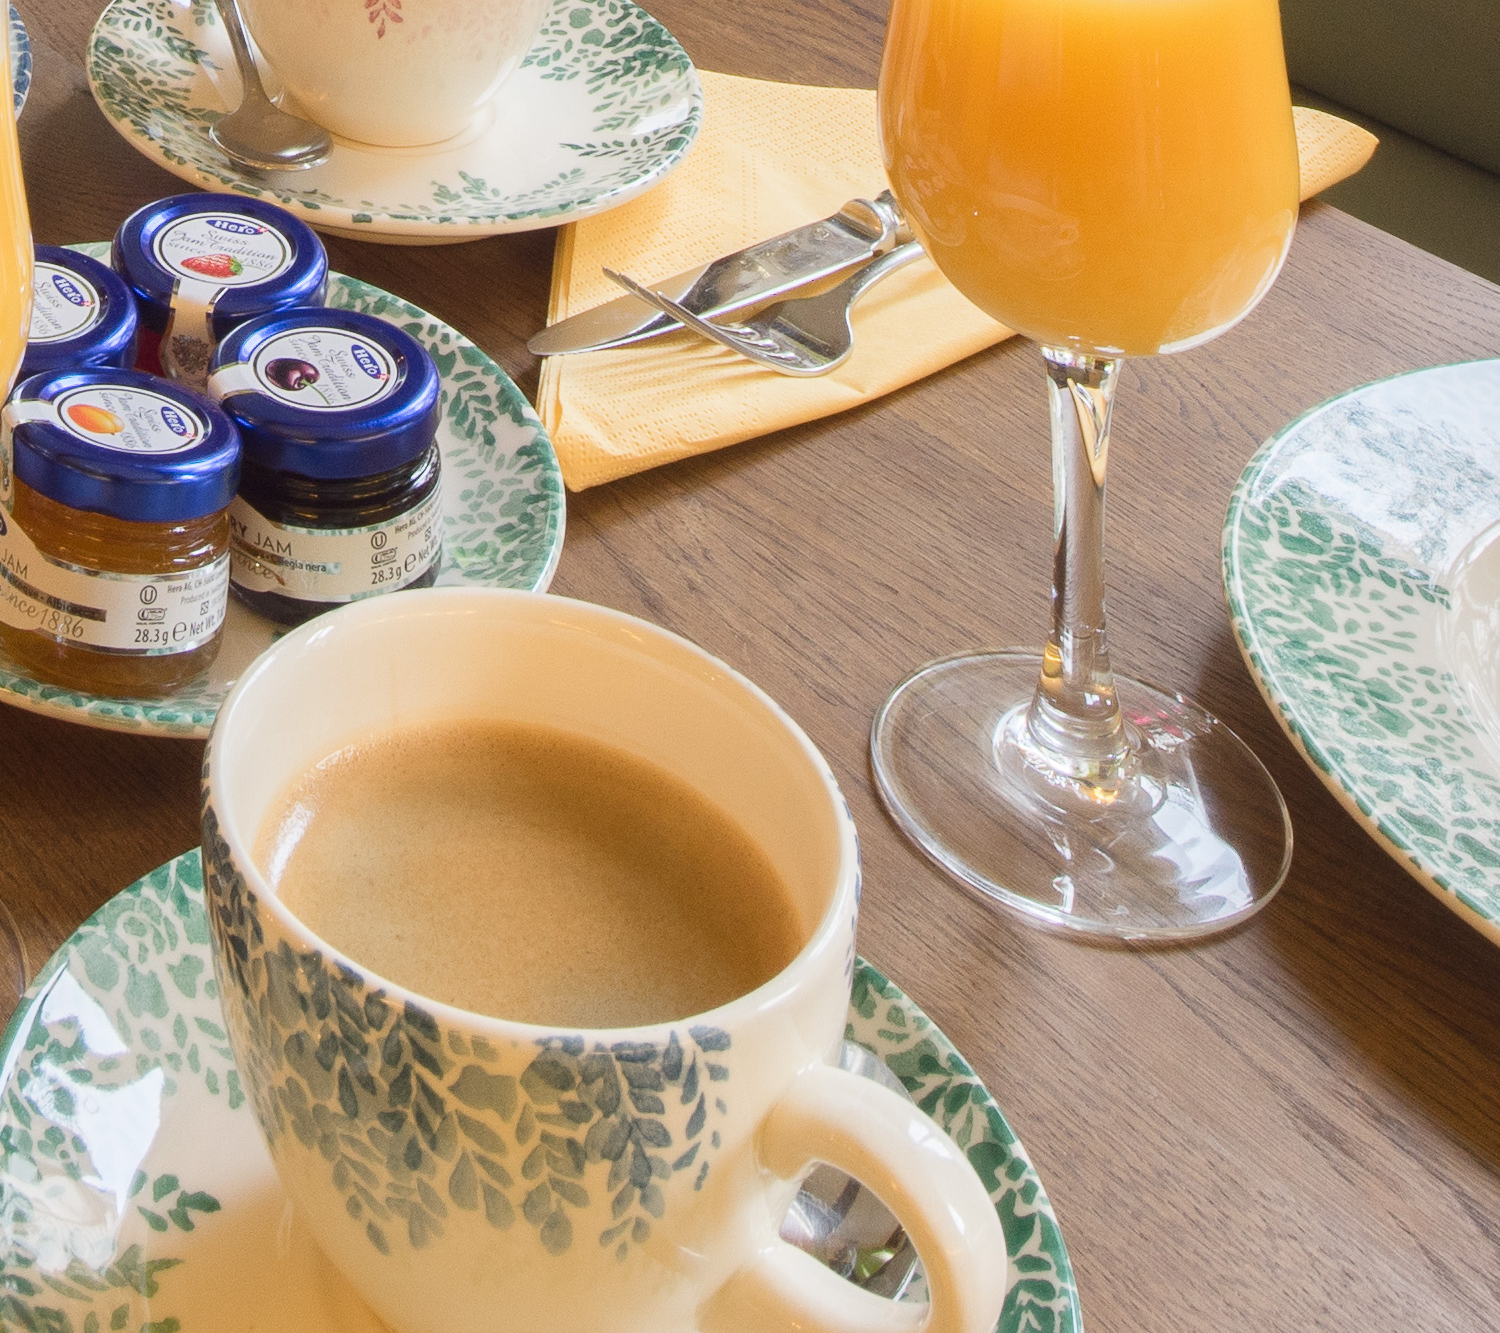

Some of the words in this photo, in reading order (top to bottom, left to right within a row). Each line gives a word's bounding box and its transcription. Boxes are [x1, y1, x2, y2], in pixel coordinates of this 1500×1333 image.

[201, 230, 249, 246] Swiss
[214, 219, 256, 235] Hero
[206, 239, 277, 261] Tradition
[54, 278, 82, 304] Hero
[354, 348, 378, 376] Hero
[163, 410, 185, 435] Hero
[253, 532, 292, 557] JAM
[1, 548, 29, 579] JAM
[39, 609, 85, 639] 1886
